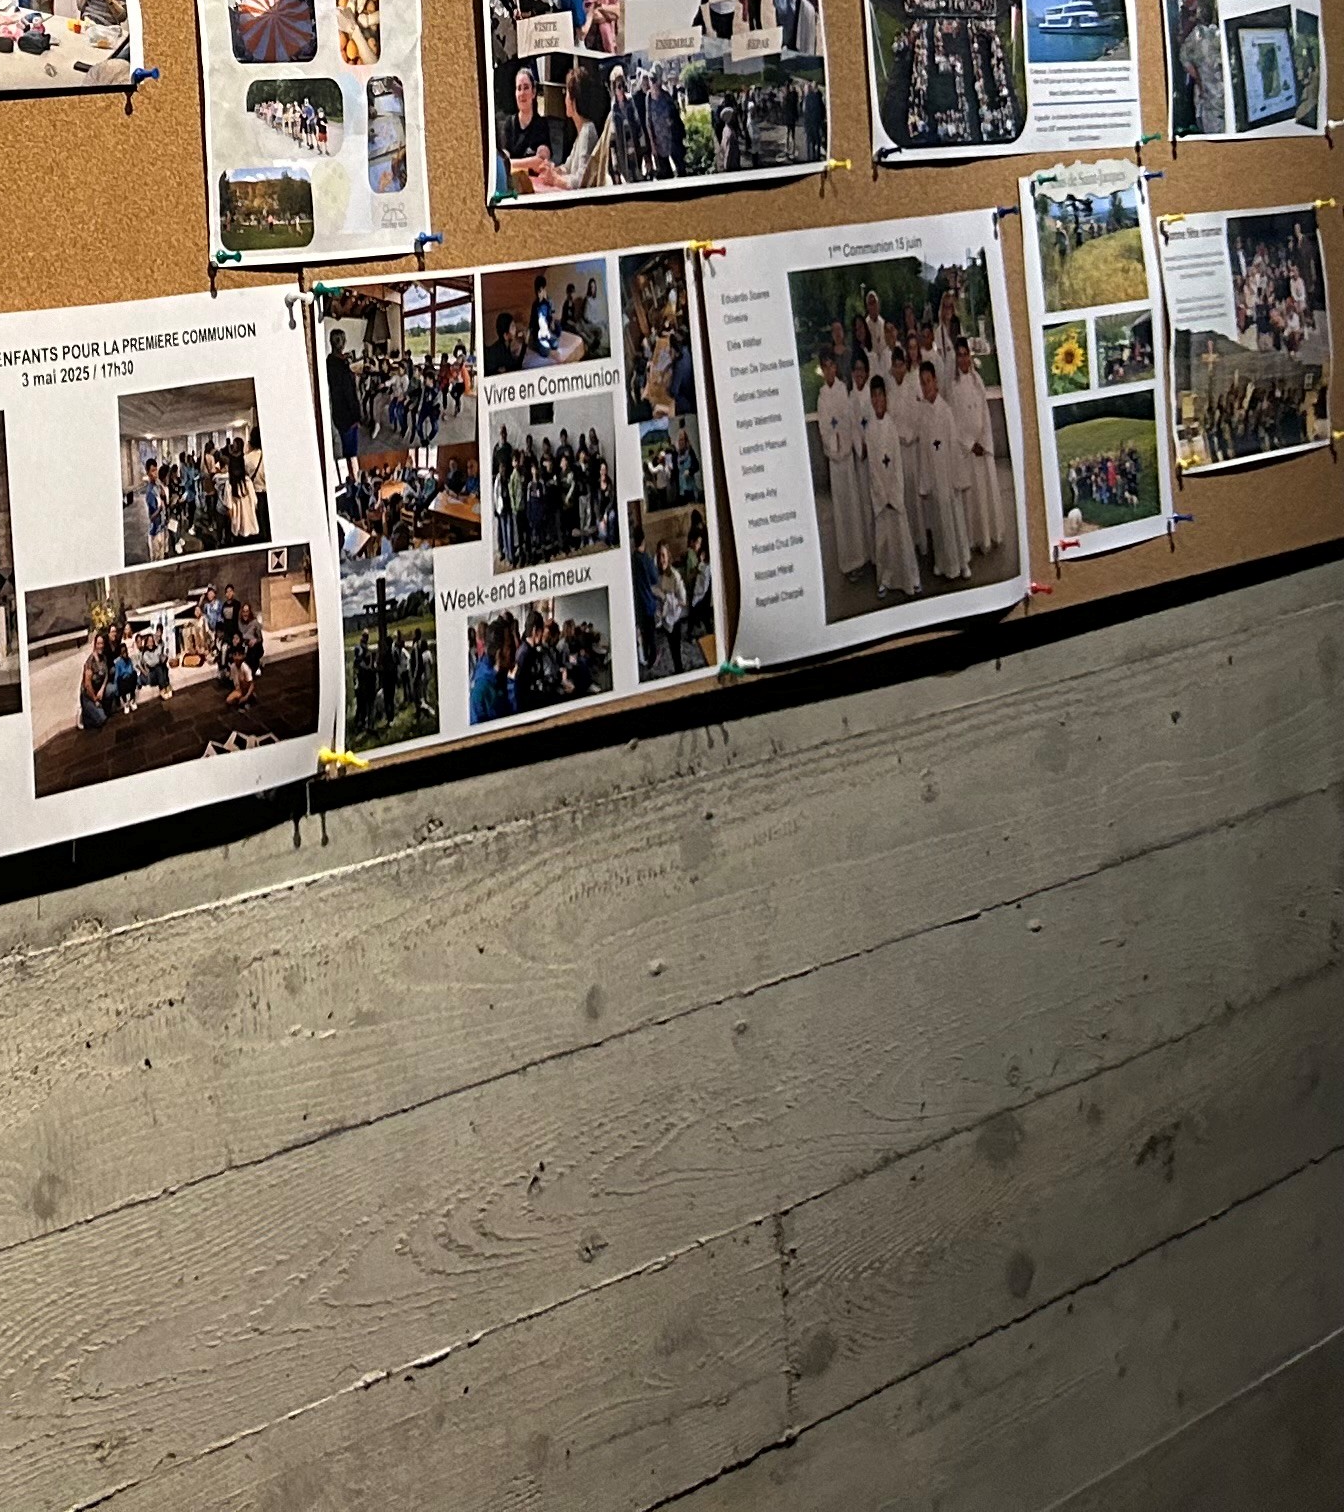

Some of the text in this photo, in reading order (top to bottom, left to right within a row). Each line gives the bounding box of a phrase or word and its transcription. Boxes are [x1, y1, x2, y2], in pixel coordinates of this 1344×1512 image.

[842, 240, 893, 258] Communion
[906, 235, 923, 252] juin
[61, 342, 101, 361] POUR
[102, 339, 119, 357] LA
[121, 333, 180, 354] PREMIERE
[181, 322, 257, 346] COMMUNION
[21, 373, 29, 387] 3
[32, 370, 58, 387] mai
[60, 365, 90, 384] 2025
[100, 361, 135, 380] 17h30
[483, 368, 621, 406] Vivre en Communion
[440, 565, 593, 612] Week-end à Raimeux
